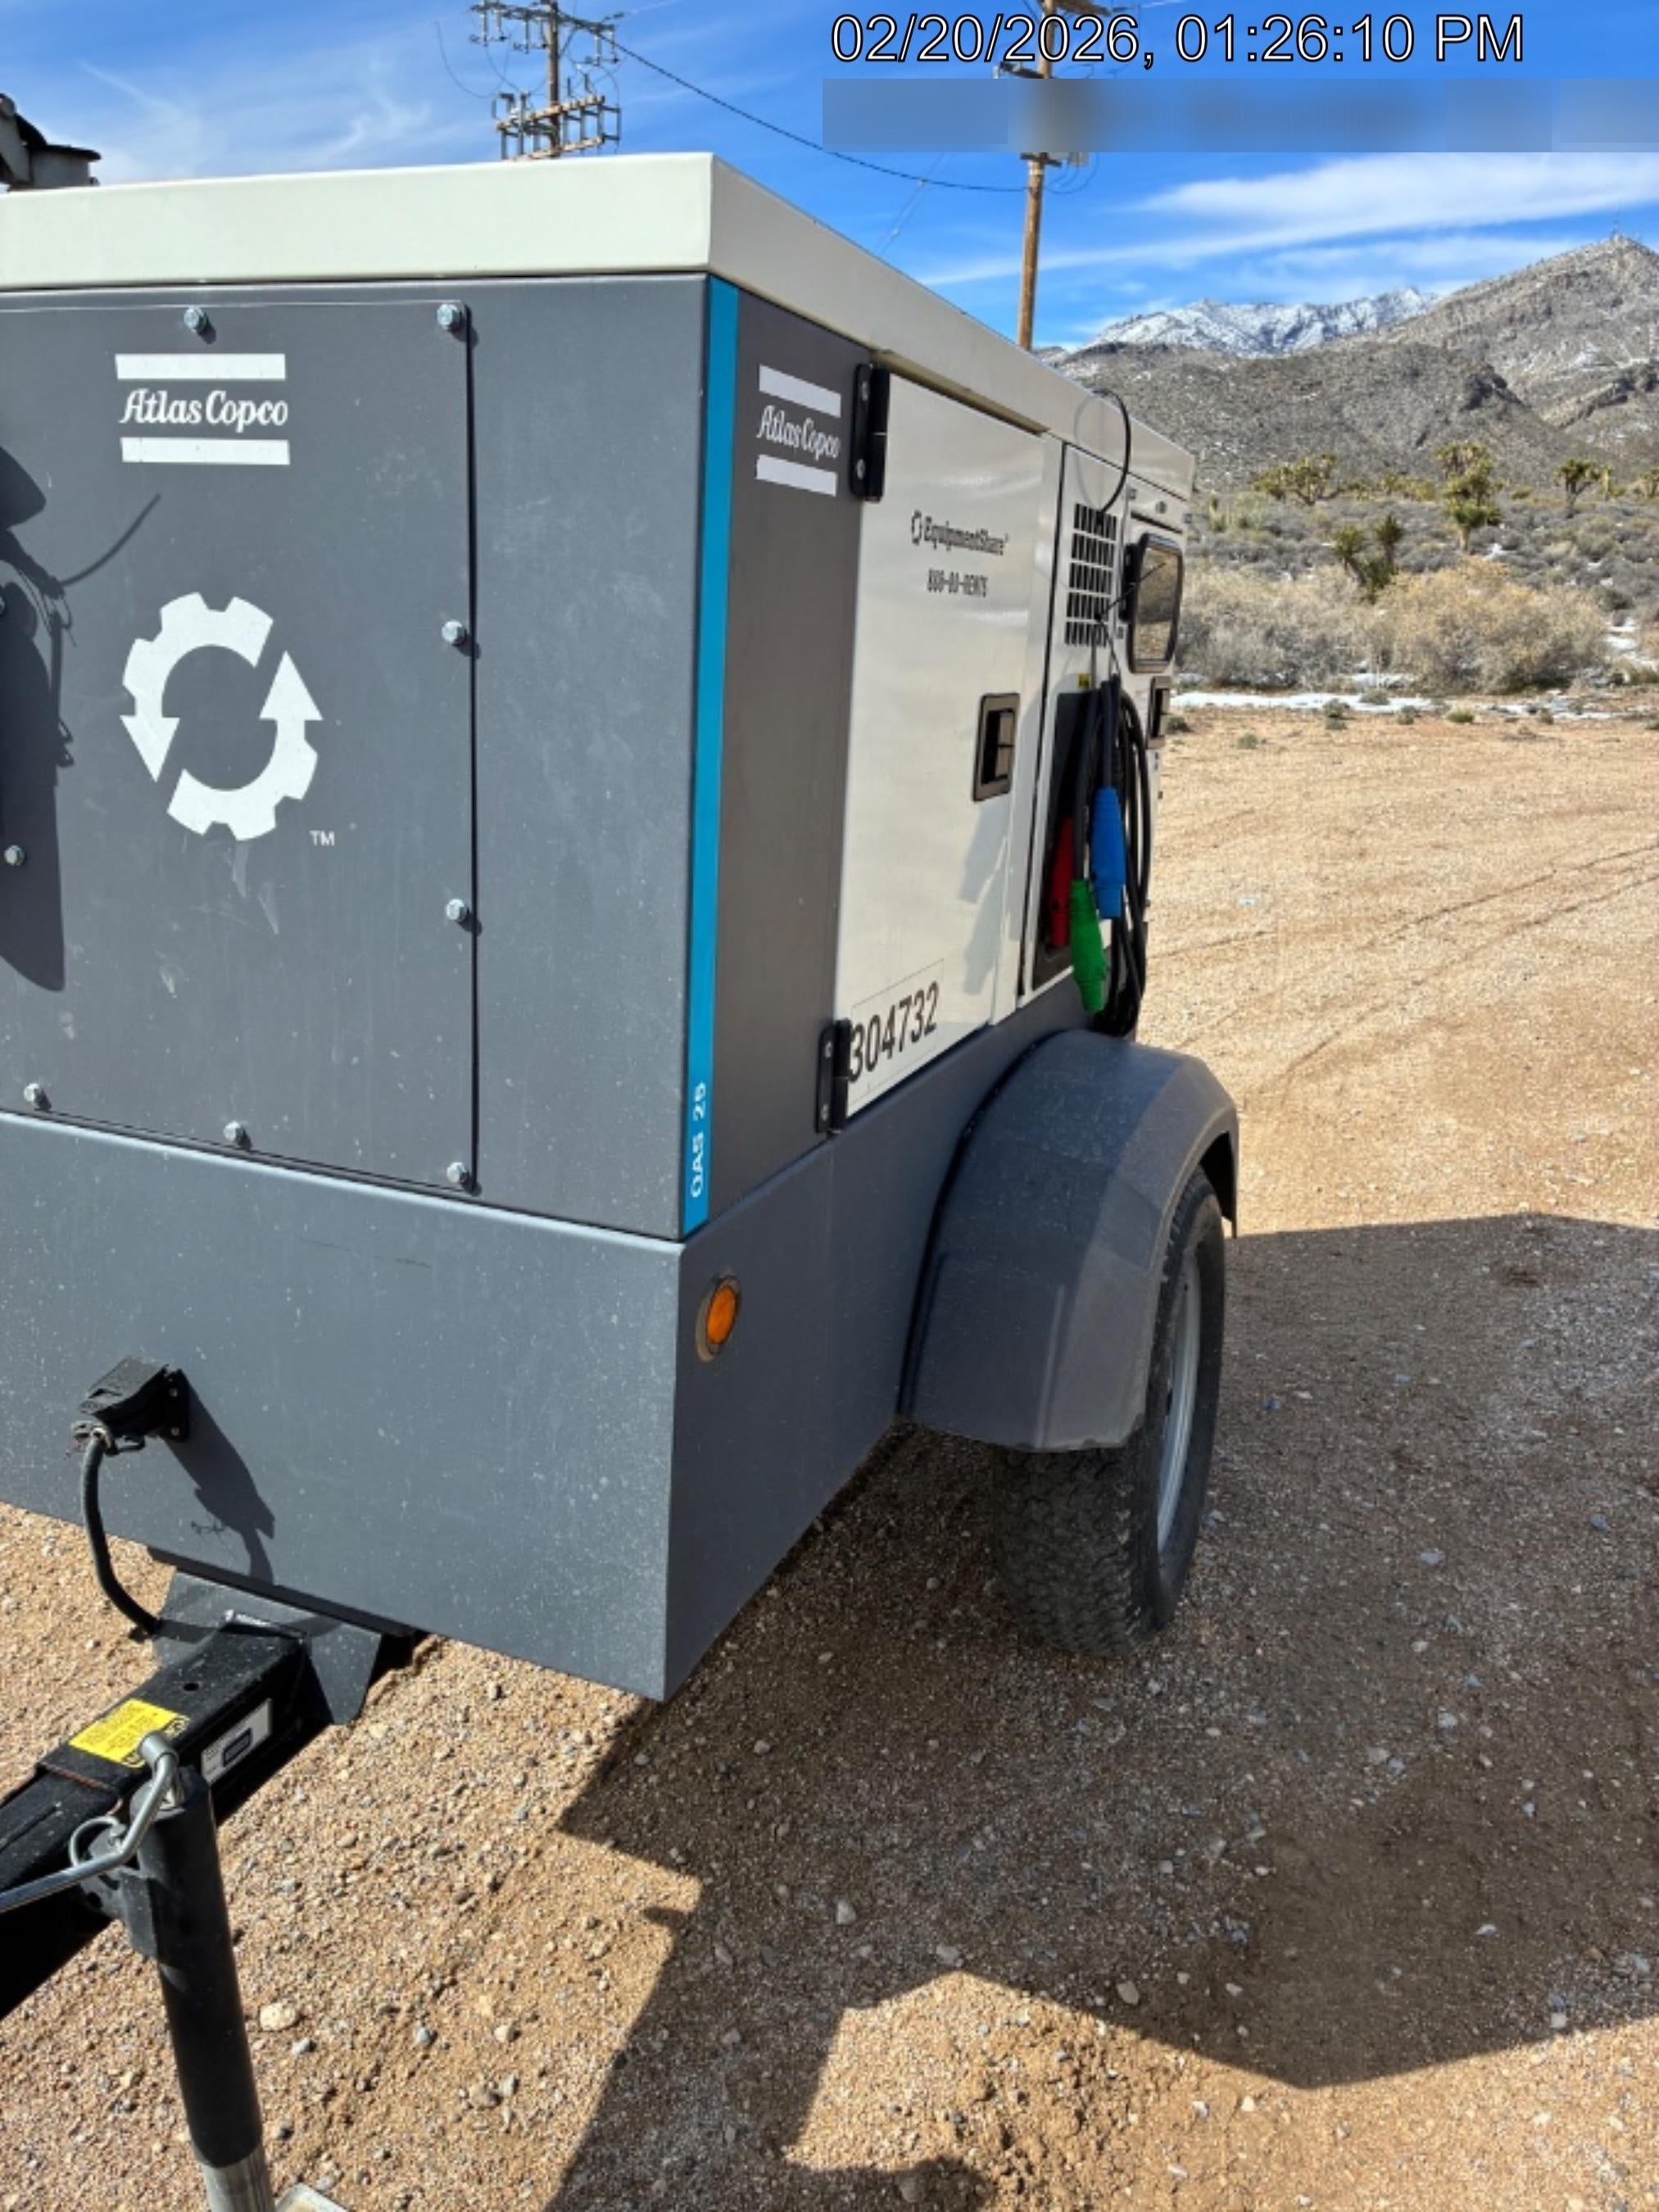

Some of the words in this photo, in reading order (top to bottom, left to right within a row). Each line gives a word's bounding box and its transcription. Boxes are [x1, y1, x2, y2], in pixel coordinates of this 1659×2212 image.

[119, 388, 202, 424] Atlas
[205, 389, 288, 433] Copco
[756, 405, 802, 448] Atlas
[802, 417, 841, 460] Copco
[309, 830, 335, 846] TM
[850, 981, 939, 1083] 304732
[690, 1131, 704, 1198] QAS
